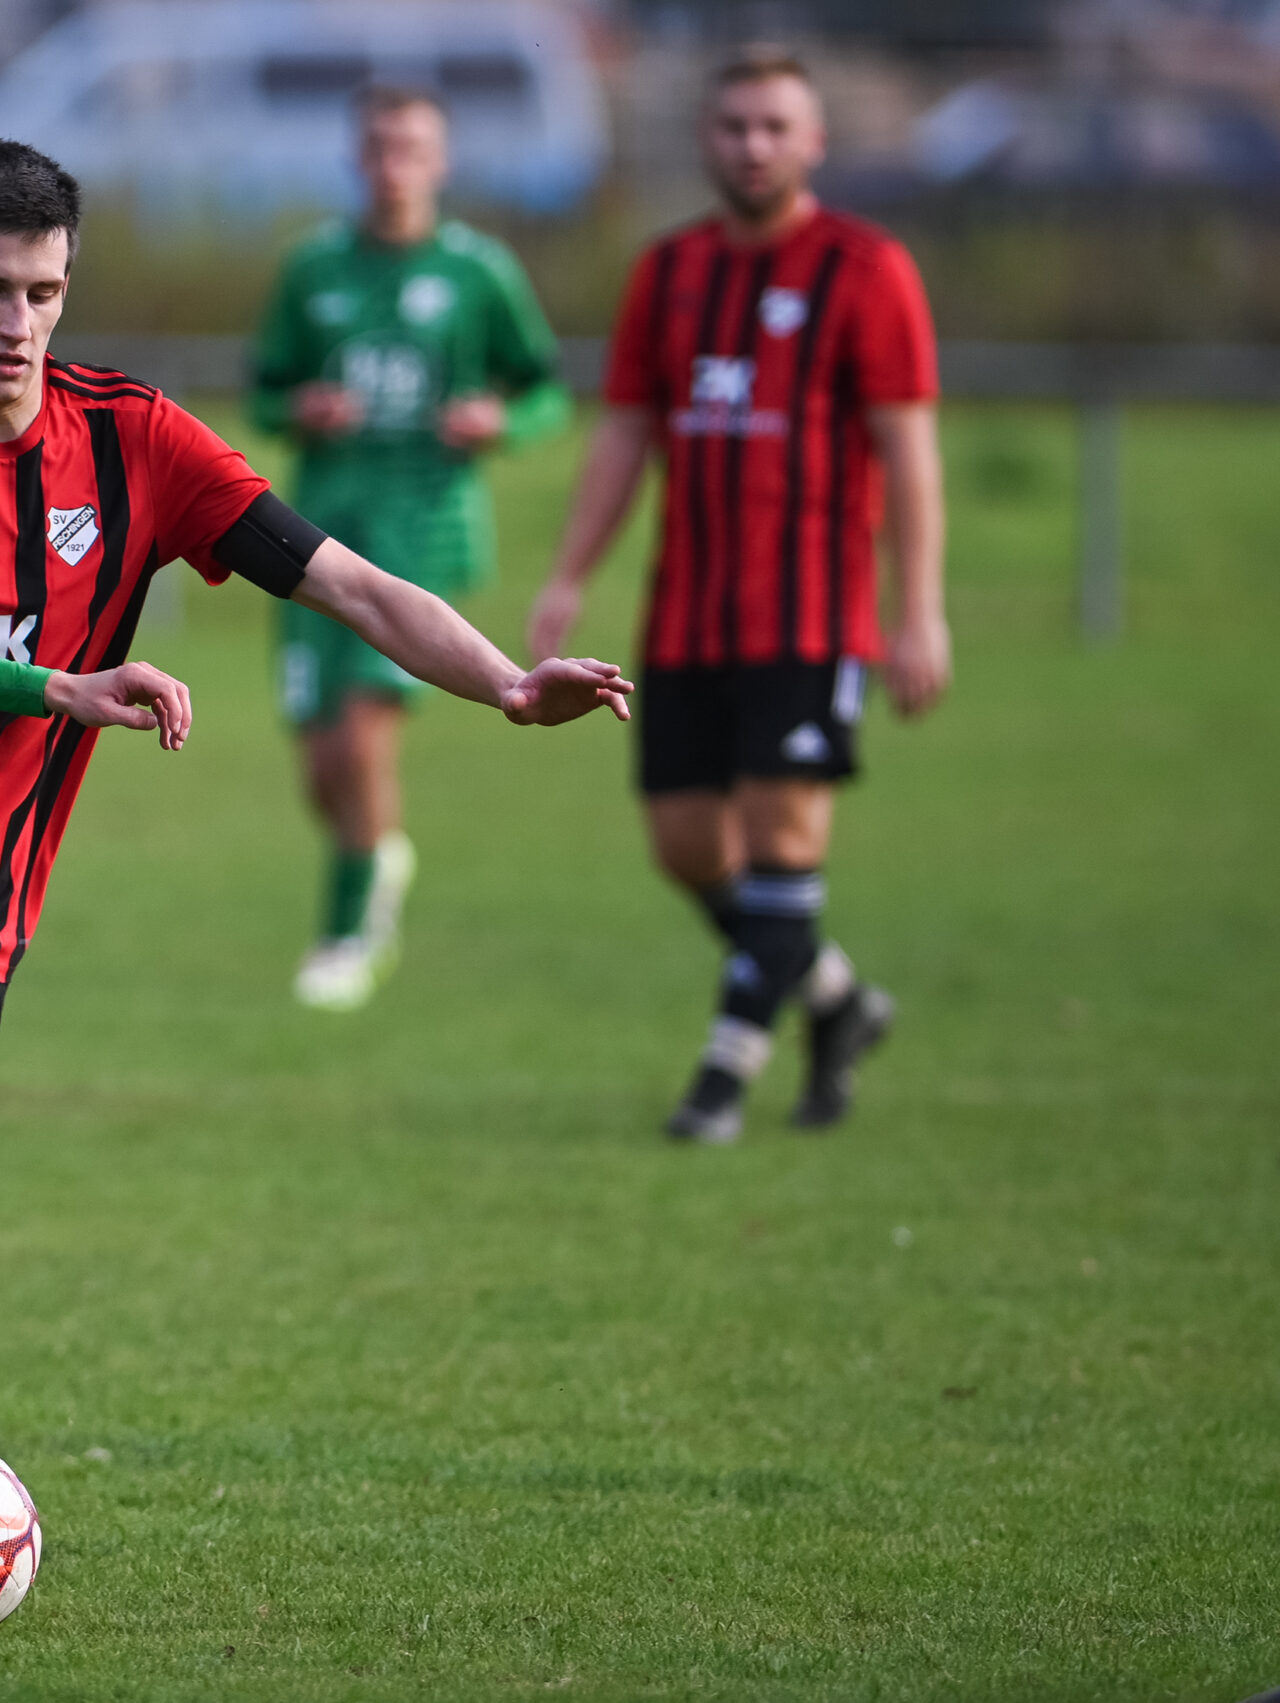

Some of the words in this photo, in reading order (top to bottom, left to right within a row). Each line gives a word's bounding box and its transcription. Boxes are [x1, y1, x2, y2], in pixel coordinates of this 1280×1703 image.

[53, 515, 67, 525] SV
[52, 506, 95, 551] FISCHINGEN
[66, 543, 85, 552] 1921
